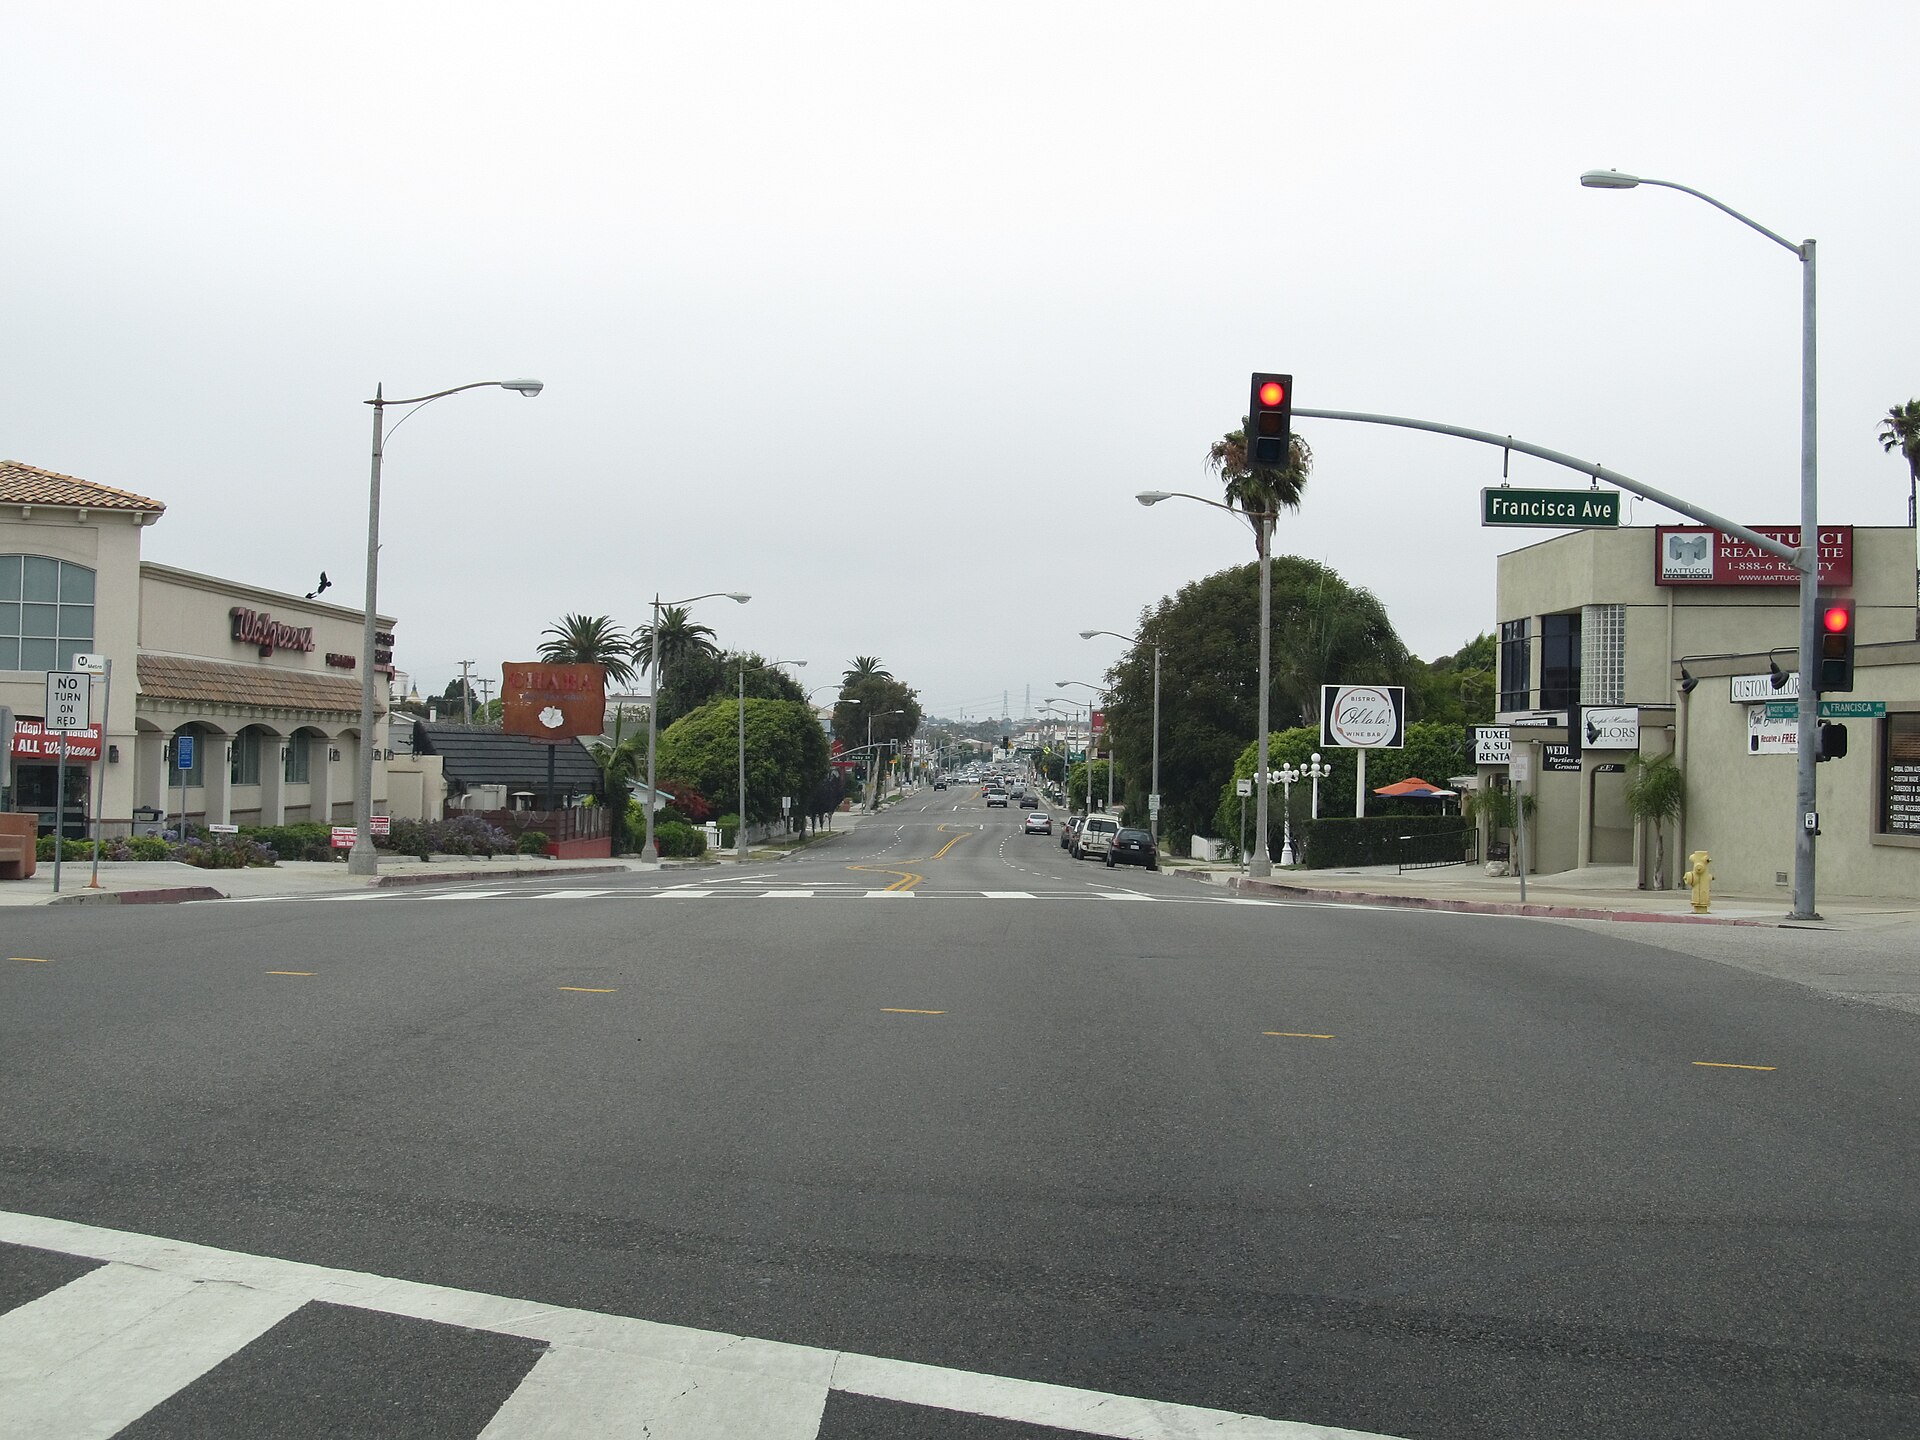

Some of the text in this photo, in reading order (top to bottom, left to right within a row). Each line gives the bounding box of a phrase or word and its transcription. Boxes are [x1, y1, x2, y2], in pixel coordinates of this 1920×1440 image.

[1492, 498, 1612, 518] Francisca Ave
[1720, 547, 1769, 558] REAL
[1728, 562, 1773, 570] 1-888-6
[232, 607, 315, 656] Walgreens
[57, 678, 78, 690] NO
[1734, 680, 1768, 698] CUSTOM
[54, 692, 81, 702] TURN
[60, 704, 74, 713] ON
[1830, 703, 1872, 712] FRANCISCA
[56, 716, 76, 725] RED
[14, 720, 42, 736] (Tdap)
[1760, 734, 1778, 743] Receive
[1782, 733, 1797, 744] FREE
[18, 739, 40, 753] ALL
[43, 741, 97, 759] Wagreens
[1483, 742, 1491, 750] &
[1908, 775, 1919, 783] MADE
